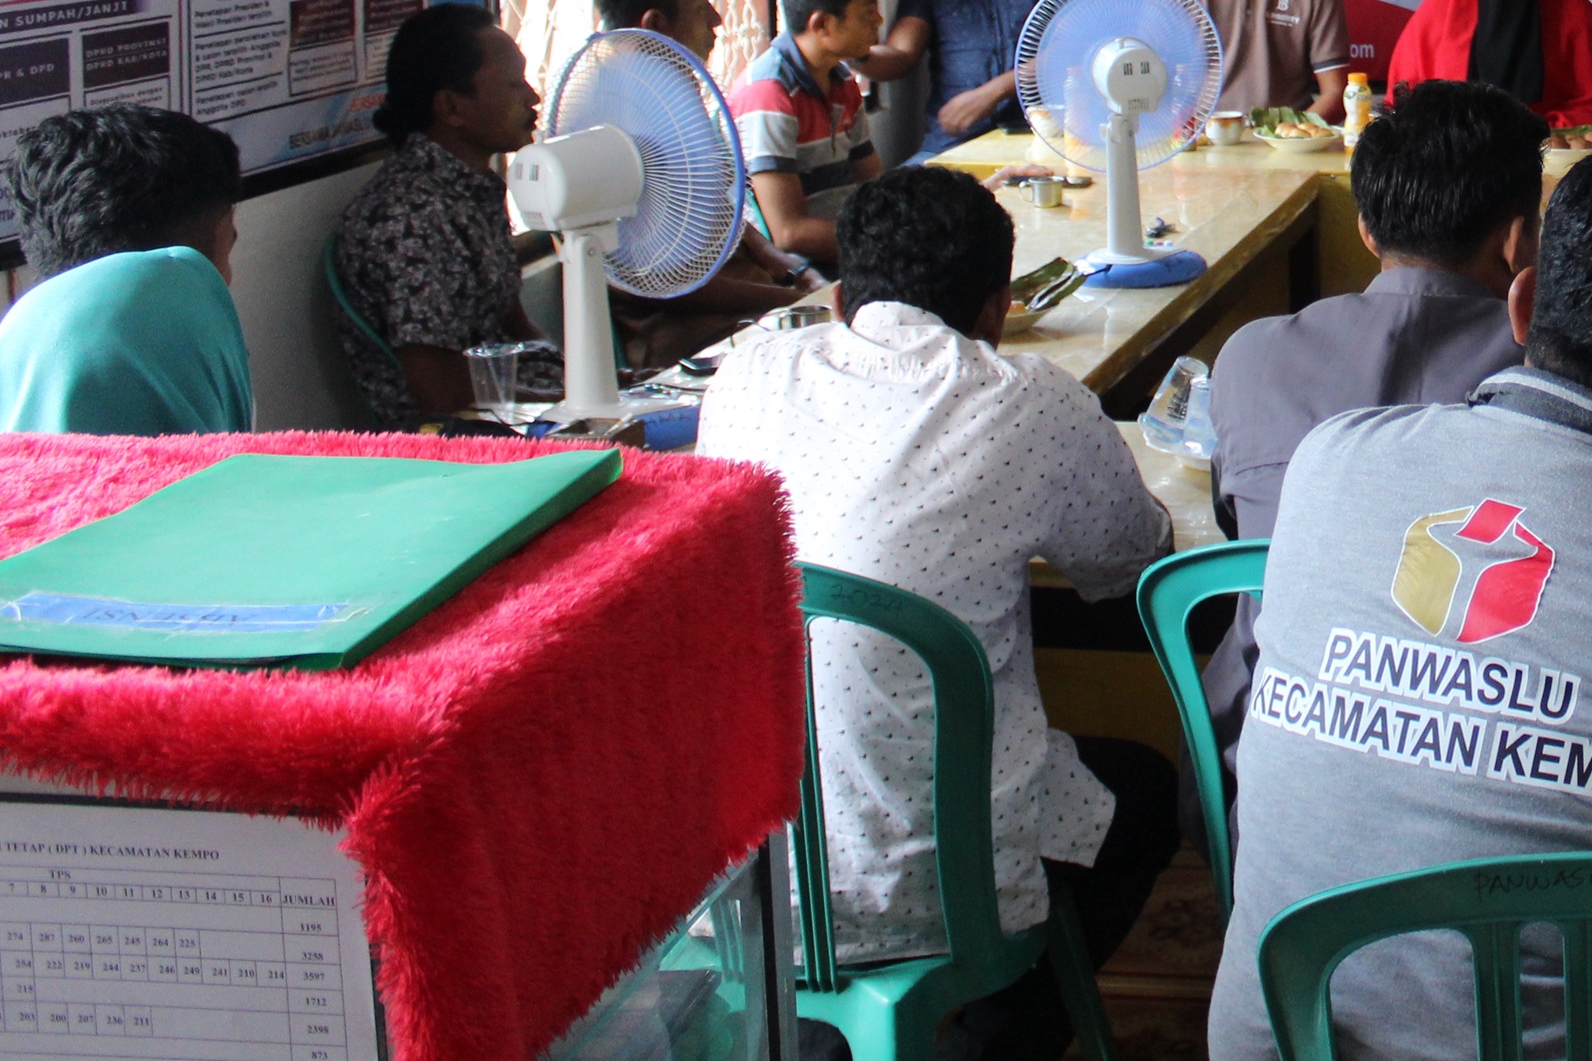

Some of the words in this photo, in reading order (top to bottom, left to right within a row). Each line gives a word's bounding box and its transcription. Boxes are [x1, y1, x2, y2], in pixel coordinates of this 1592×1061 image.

[1321, 631, 1578, 722] PANWASLU
[1252, 669, 1482, 771] KECAMATAN
[90, 844, 171, 858] KECAMATAN
[174, 848, 220, 860] KEMPO
[49, 869, 72, 880] TPS
[96, 886, 108, 896] 10
[124, 887, 134, 897] 11
[152, 889, 164, 899] 12
[178, 890, 191, 900] 13
[205, 891, 217, 901] 14
[232, 892, 245, 902] 15
[261, 894, 272, 904] 16
[282, 894, 336, 907] JUMLAH
[184, 966, 200, 976] 249
[212, 967, 228, 977] 241
[268, 970, 285, 980] 214
[303, 972, 325, 981] 3597
